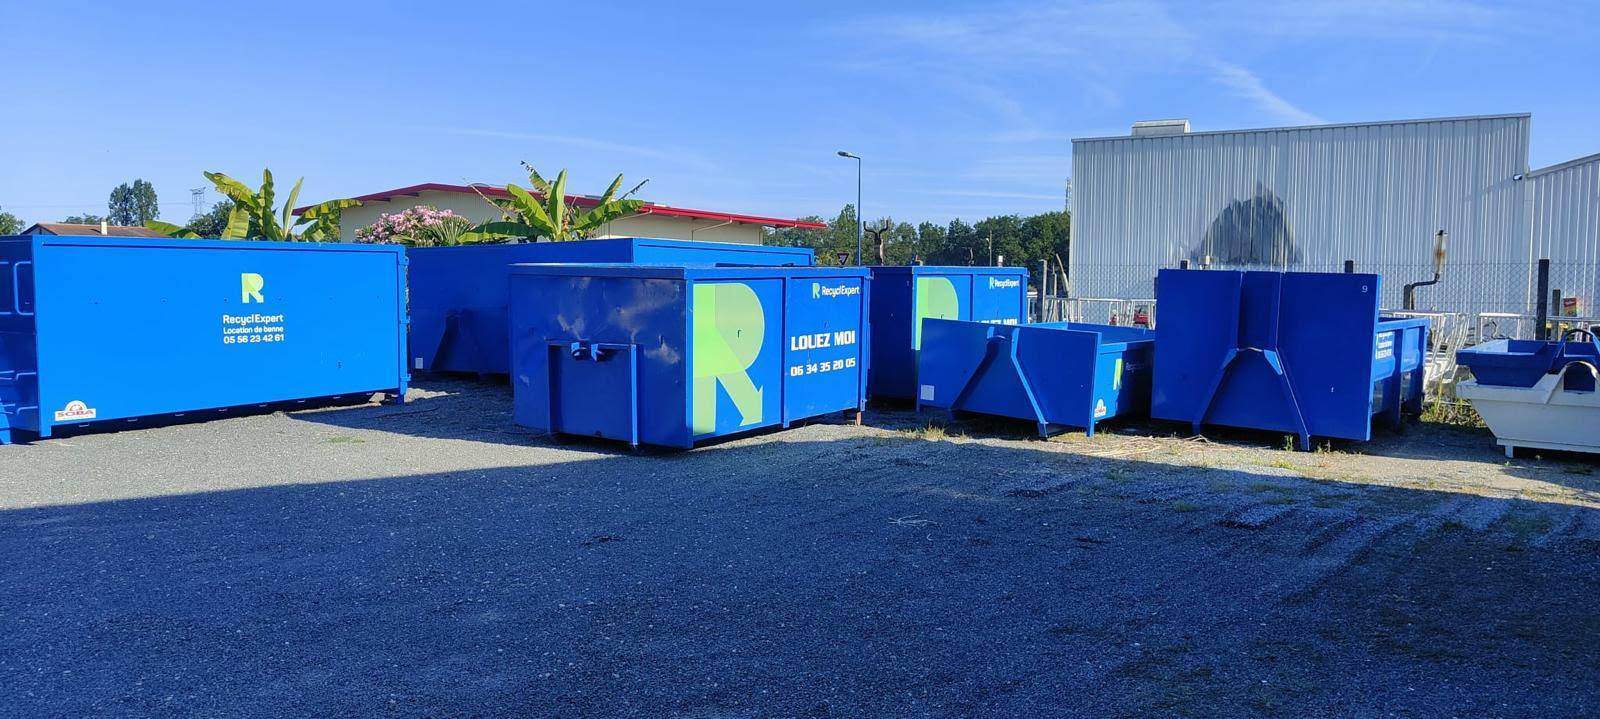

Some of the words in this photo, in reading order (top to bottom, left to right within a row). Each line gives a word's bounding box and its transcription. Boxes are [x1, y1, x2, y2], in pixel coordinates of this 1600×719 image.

[241, 272, 264, 304] R
[812, 282, 820, 299] R
[821, 285, 860, 298] RecyclExpert
[222, 314, 284, 326] RecyclExpert
[224, 326, 253, 334] Location
[224, 336, 236, 344] 05
[237, 335, 248, 344] 56
[250, 334, 261, 343] 23
[262, 334, 274, 342] 42
[274, 334, 284, 342] 61
[790, 332, 832, 352] LOUEZ
[834, 330, 856, 346] MOI
[692, 282, 765, 436] R
[790, 365, 804, 378] 06
[805, 363, 818, 376] 34
[819, 361, 832, 373] 35
[832, 359, 844, 371] 20
[845, 357, 857, 368] 05
